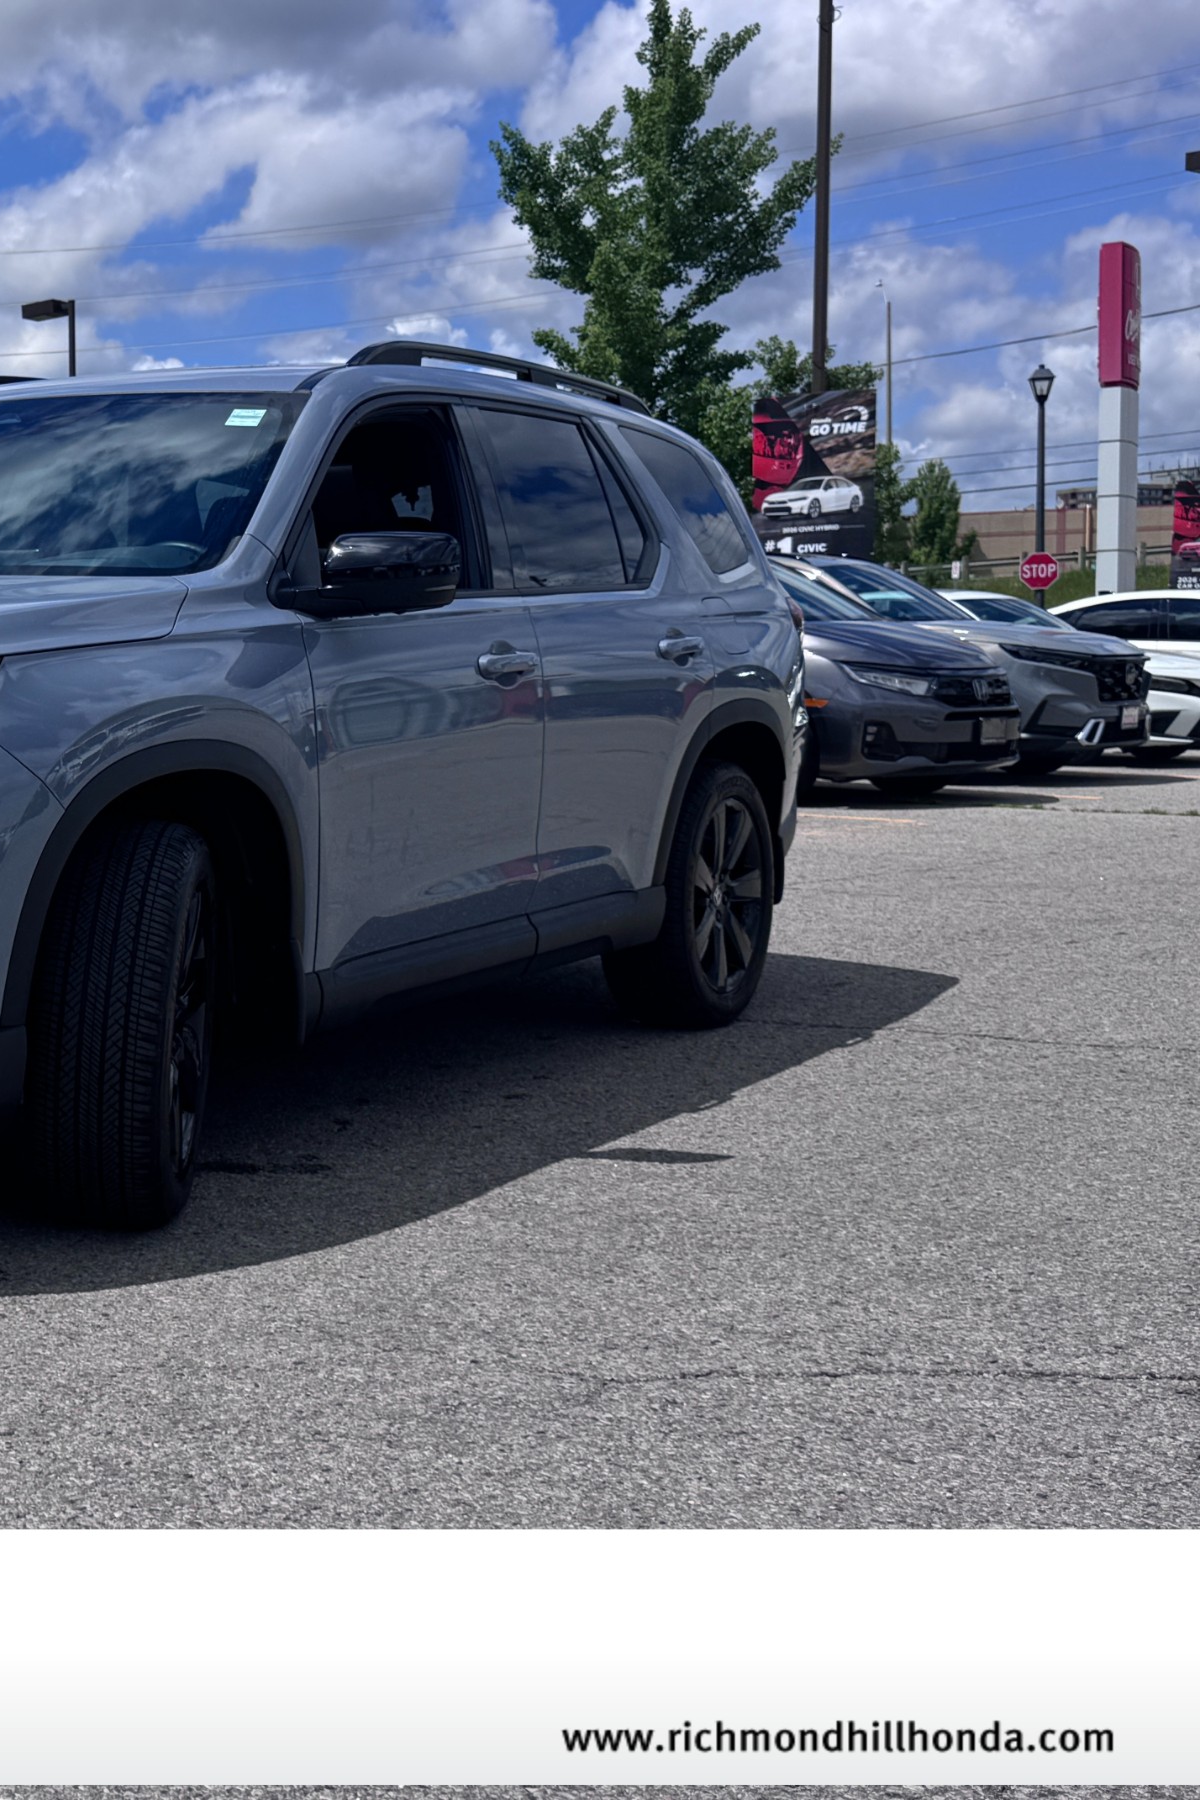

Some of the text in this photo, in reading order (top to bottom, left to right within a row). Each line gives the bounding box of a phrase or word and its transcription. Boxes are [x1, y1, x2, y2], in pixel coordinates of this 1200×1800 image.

[809, 421, 867, 437] GO TIME
[797, 542, 828, 553] CIVIC
[1022, 563, 1057, 579] STOP
